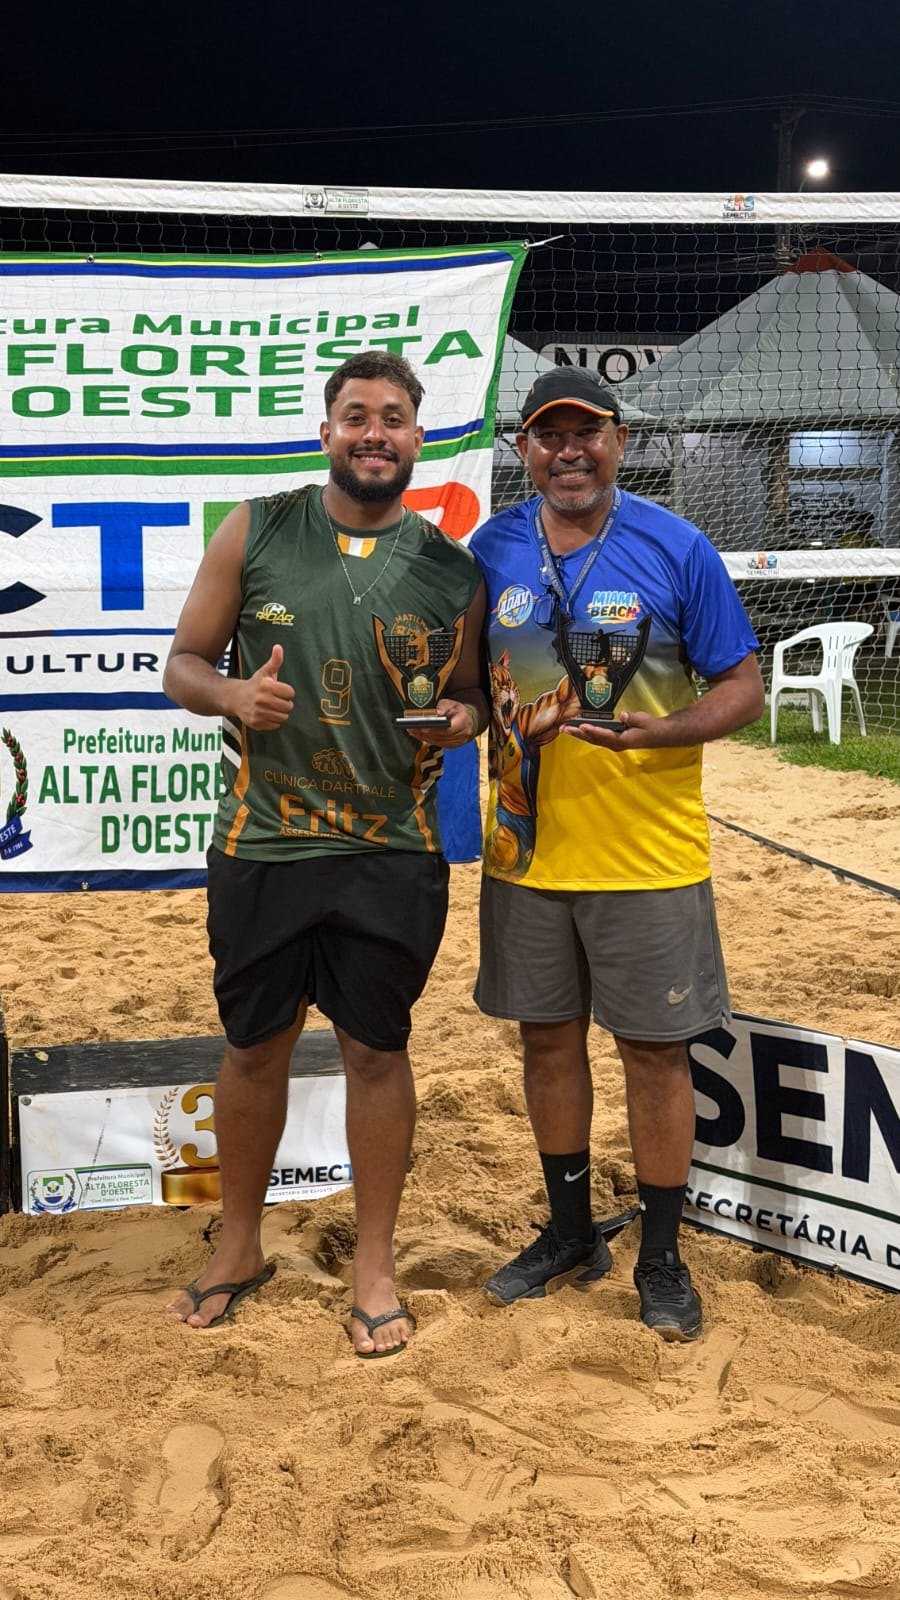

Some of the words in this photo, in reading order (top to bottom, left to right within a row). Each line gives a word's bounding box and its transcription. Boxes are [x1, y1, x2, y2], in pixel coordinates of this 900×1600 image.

[132, 305, 420, 338] Municipal
[7, 329, 484, 377] FLORESTA
[12, 384, 305, 418] OESTE
[590, 605, 638, 618] BEACH
[592, 591, 638, 606] MIAMI
[320, 658, 352, 718] 9
[63, 727, 166, 754] Prefeitura
[38, 764, 122, 804] ALTA
[263, 769, 318, 790] CLÍNICA
[101, 812, 218, 853] D'OEST
[280, 792, 389, 844] Fritz
[84, 1182, 107, 1191] ALTA
[107, 1178, 151, 1189] FLORESTA
[100, 1187, 135, 1197] D'OESTE
